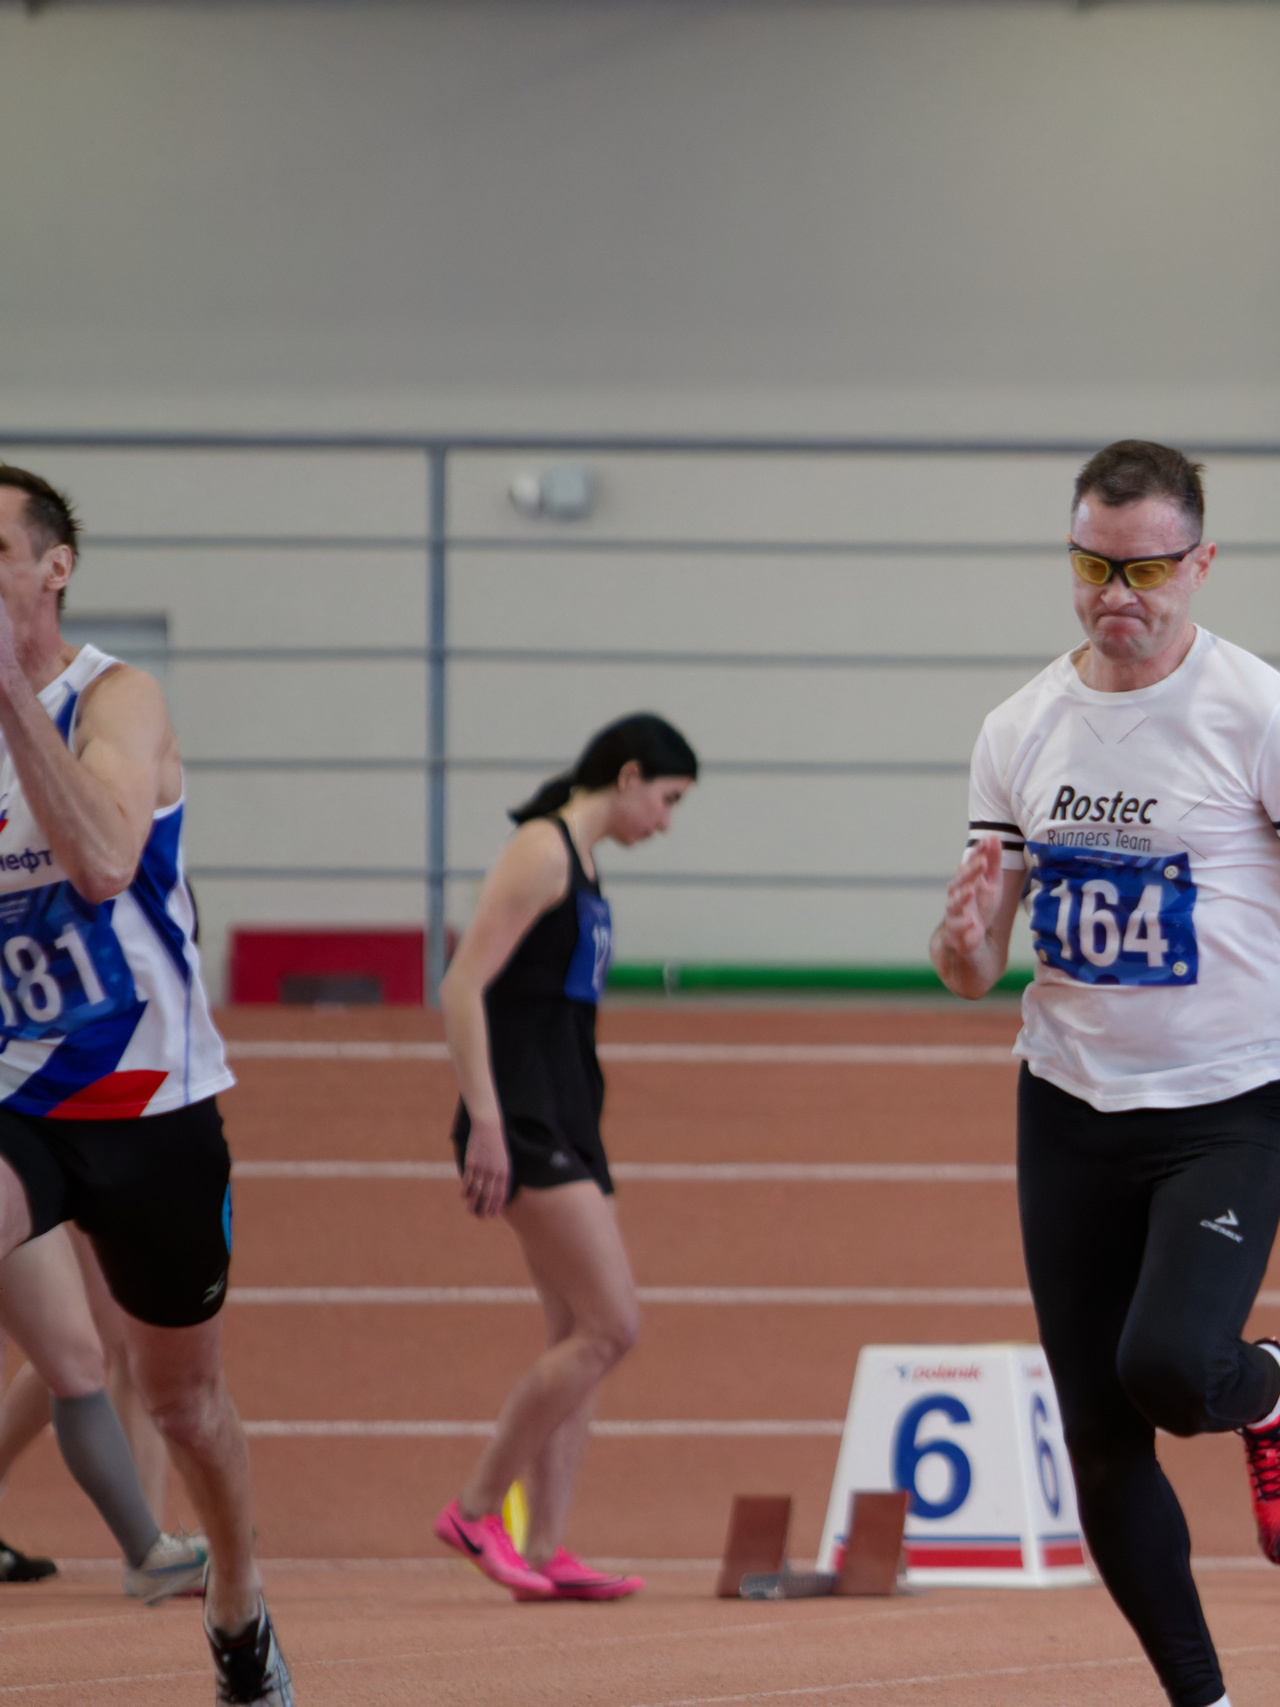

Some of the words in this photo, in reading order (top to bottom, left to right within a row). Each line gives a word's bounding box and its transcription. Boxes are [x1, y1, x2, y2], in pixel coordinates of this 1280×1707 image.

[1049, 785, 1158, 825] Rostec
[1047, 829, 1110, 847] Runners
[1115, 829, 1151, 853] Team
[1050, 879, 1169, 968] 164
[890, 1393, 972, 1520] 6
